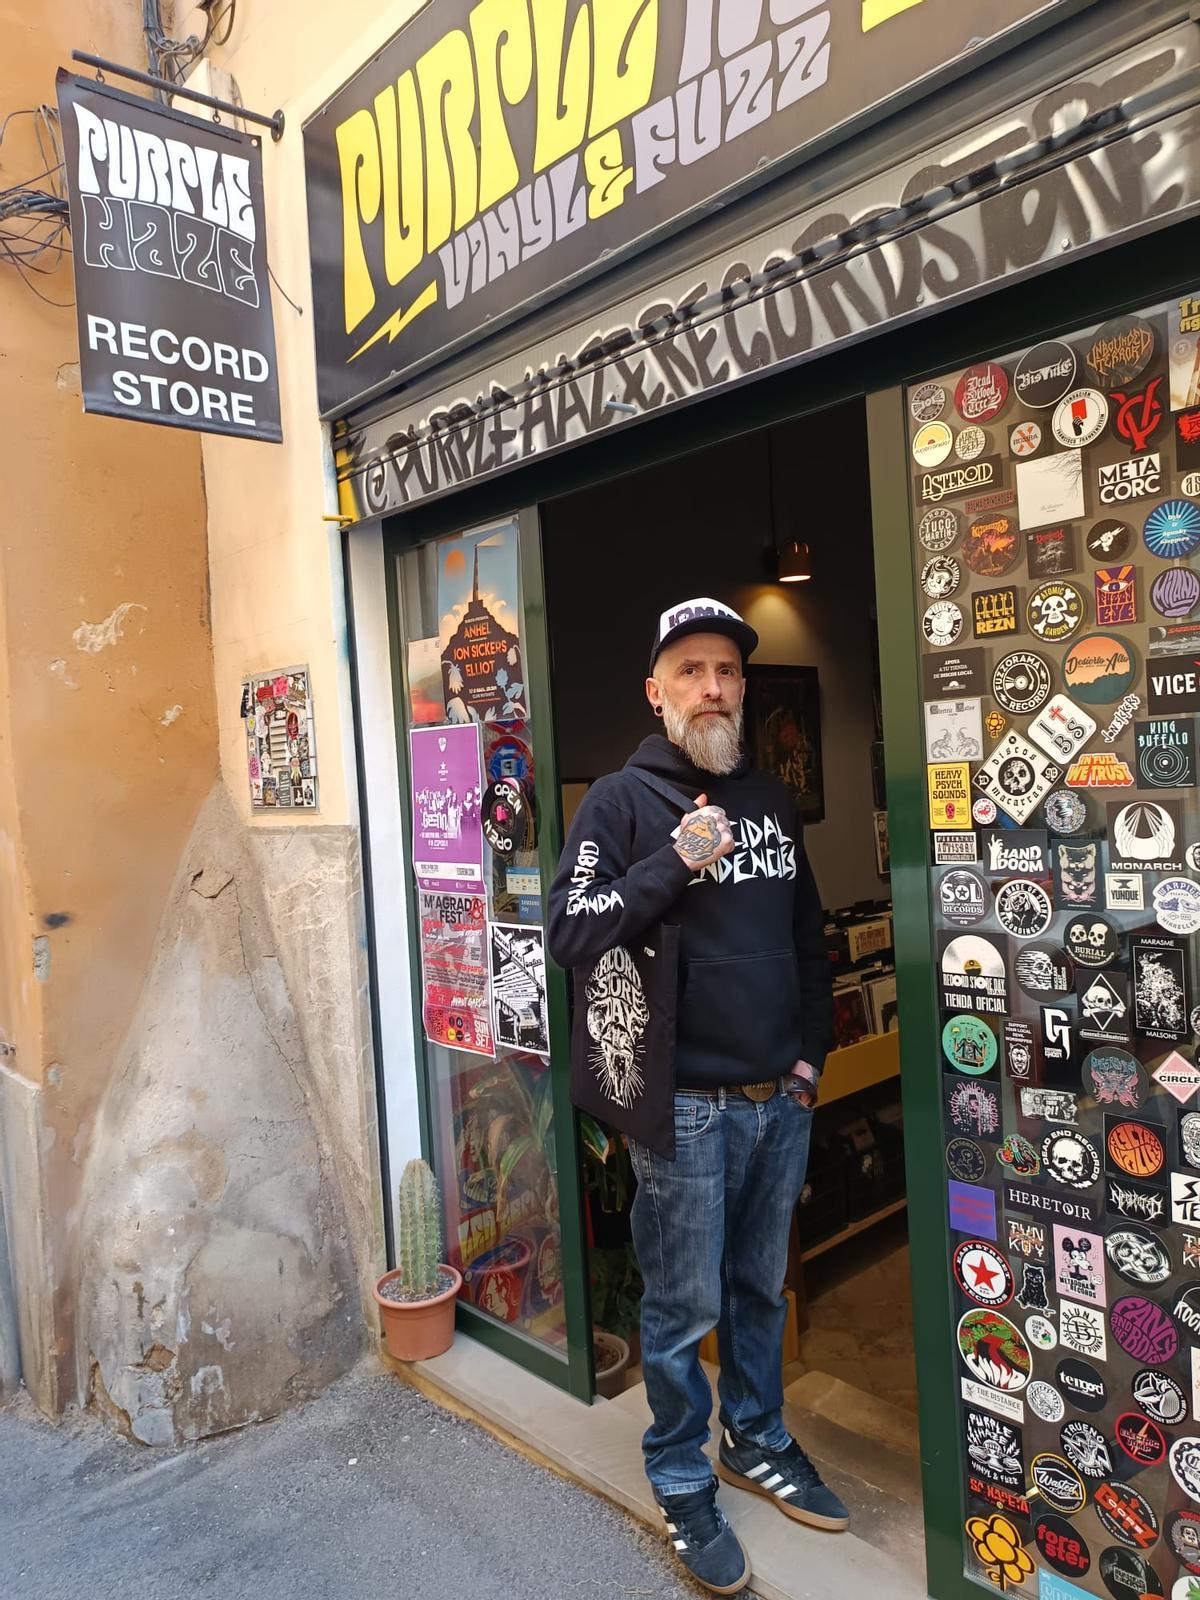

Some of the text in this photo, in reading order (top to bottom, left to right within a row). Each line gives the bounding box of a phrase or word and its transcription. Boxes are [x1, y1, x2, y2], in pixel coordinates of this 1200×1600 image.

[437, 153, 587, 310] VINYL
[584, 129, 633, 220] &
[631, 10, 831, 194] FUZZ
[73, 102, 256, 242] PURPLE
[87, 314, 270, 384] RECORD
[113, 370, 257, 427] STORE
[1101, 457, 1159, 485] META
[922, 462, 993, 501] ASTEROID
[1100, 475, 1160, 503] CORC
[925, 518, 952, 532] TUCO
[925, 529, 952, 542] MARTIN
[1040, 587, 1065, 599] ATOMIC
[1100, 604, 1135, 622] EYE
[463, 622, 491, 640] ANHEL
[976, 617, 1015, 634] REZN
[1044, 624, 1069, 636] GARDEN
[453, 639, 508, 661] JON SICKERS
[465, 660, 496, 678] ELLIOT
[996, 655, 1040, 690] FUZZORAMA
[1151, 673, 1197, 696] VICE
[1009, 683, 1048, 711] RECORDS
[1150, 721, 1176, 734] KING
[1138, 732, 1189, 747] BUFFALO
[935, 770, 962, 780] HEAVY
[1068, 765, 1132, 784] WE TRUST
[933, 789, 966, 799] SOUNDS
[935, 780, 963, 789] PSYCH
[494, 783, 523, 816] OPEN
[484, 819, 513, 851] OPEN
[1000, 845, 1042, 860] HAND
[998, 859, 1044, 873] DOOM
[1111, 862, 1183, 872] MONARCH
[942, 883, 984, 903] SOL
[1006, 882, 1025, 895] MADE
[1110, 889, 1139, 902] YUNQUE
[439, 910, 463, 925] FEST
[943, 905, 983, 914] RECORDS
[1000, 910, 1041, 936] RECORDINGS
[1074, 945, 1107, 958] BURIAL
[1140, 937, 1176, 948] MARASME
[943, 973, 1006, 992] RECORD STORE DAY
[944, 992, 1008, 1014] TIENDA OFICIAL
[1159, 1075, 1200, 1084] CIRCLE
[1042, 1129, 1101, 1181] DEAD END RECORDS
[1008, 1188, 1092, 1221] HERETOIR
[962, 1281, 1008, 1305] RECORDS
[1061, 1307, 1097, 1324] BLUNT
[1062, 1333, 1087, 1353] STREET
[977, 1387, 1021, 1410] THE DISTANCE
[968, 1413, 1013, 1438] PURPLE
[1064, 1422, 1105, 1444] TRUENO
[1063, 1443, 1106, 1478] CULEBRA
[1036, 1469, 1078, 1495] Wasted
